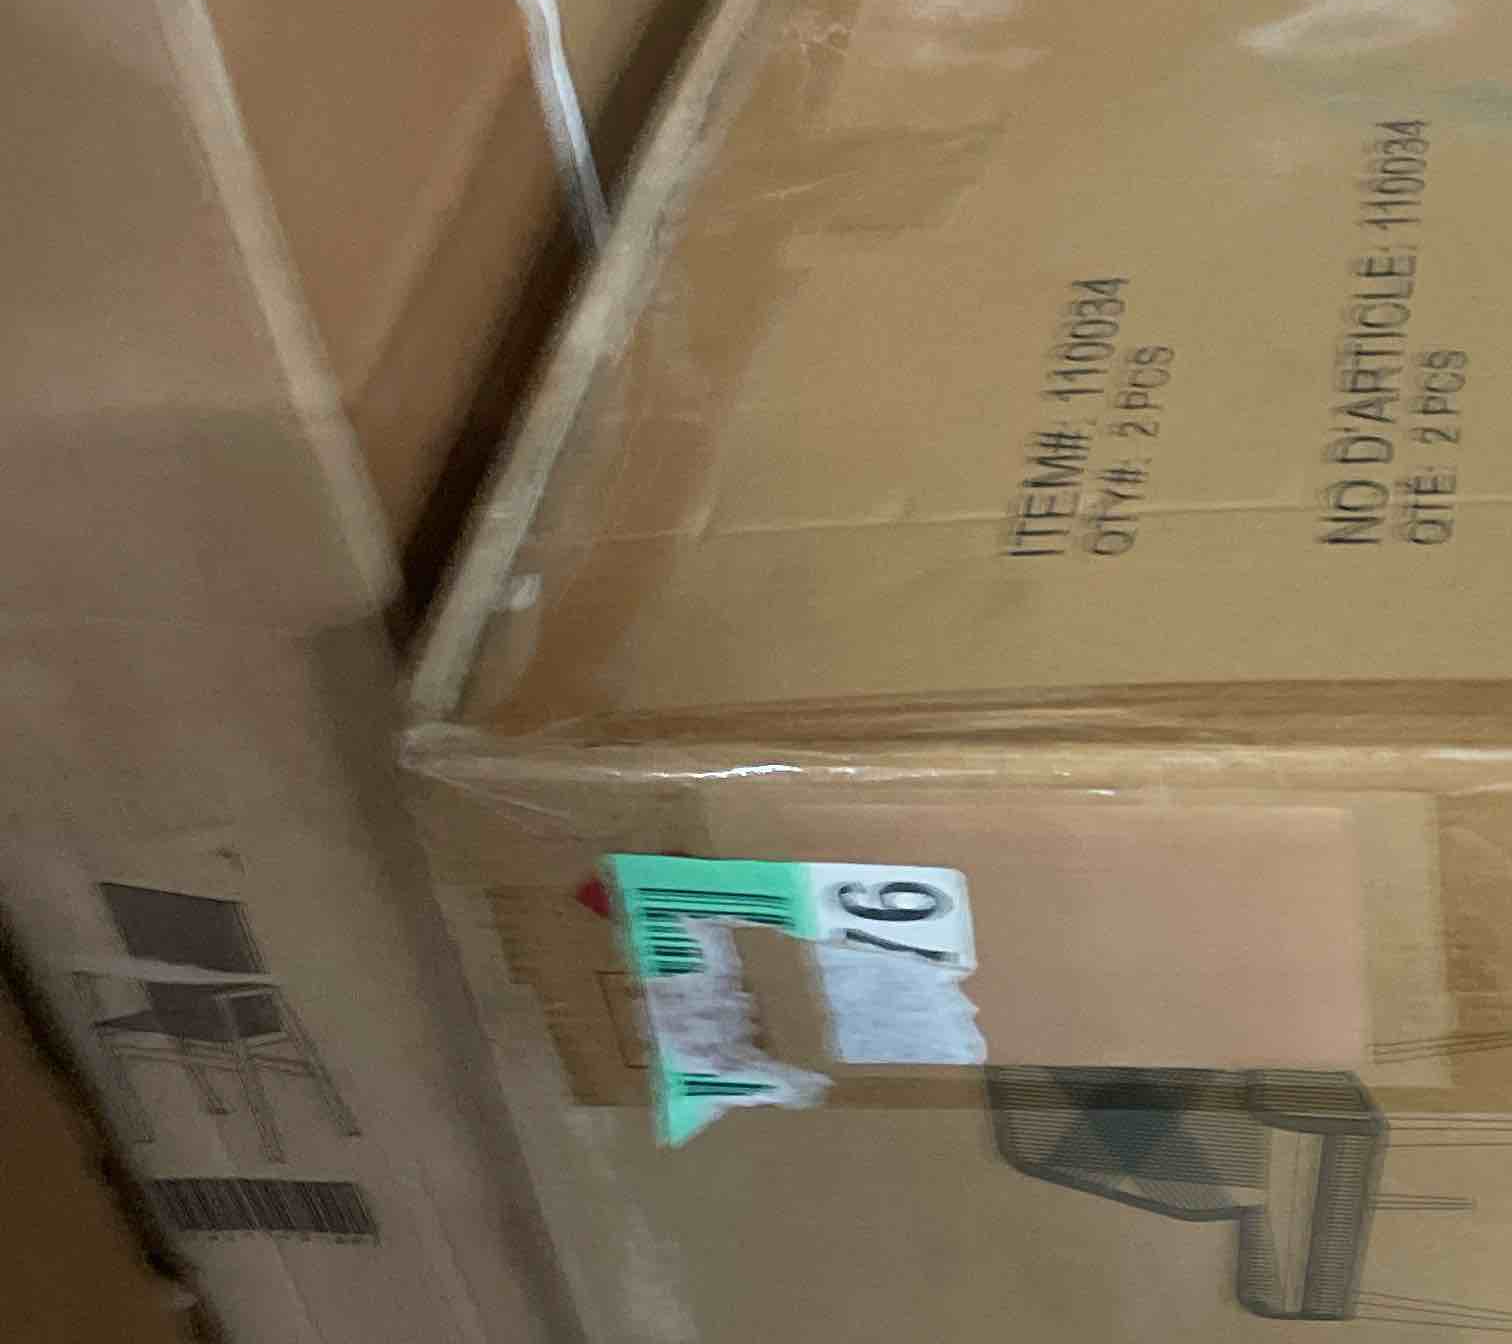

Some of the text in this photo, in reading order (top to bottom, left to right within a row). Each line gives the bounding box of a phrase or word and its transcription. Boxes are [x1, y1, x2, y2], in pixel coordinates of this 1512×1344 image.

[995, 275, 1129, 558] ITEM#: 110034
[1315, 119, 1434, 546] NO D'ARTICLE: 110034
[1408, 427, 1460, 445] 2
[1410, 350, 1468, 415] PCS
[1078, 343, 1177, 556] QTY#: 2 PCS
